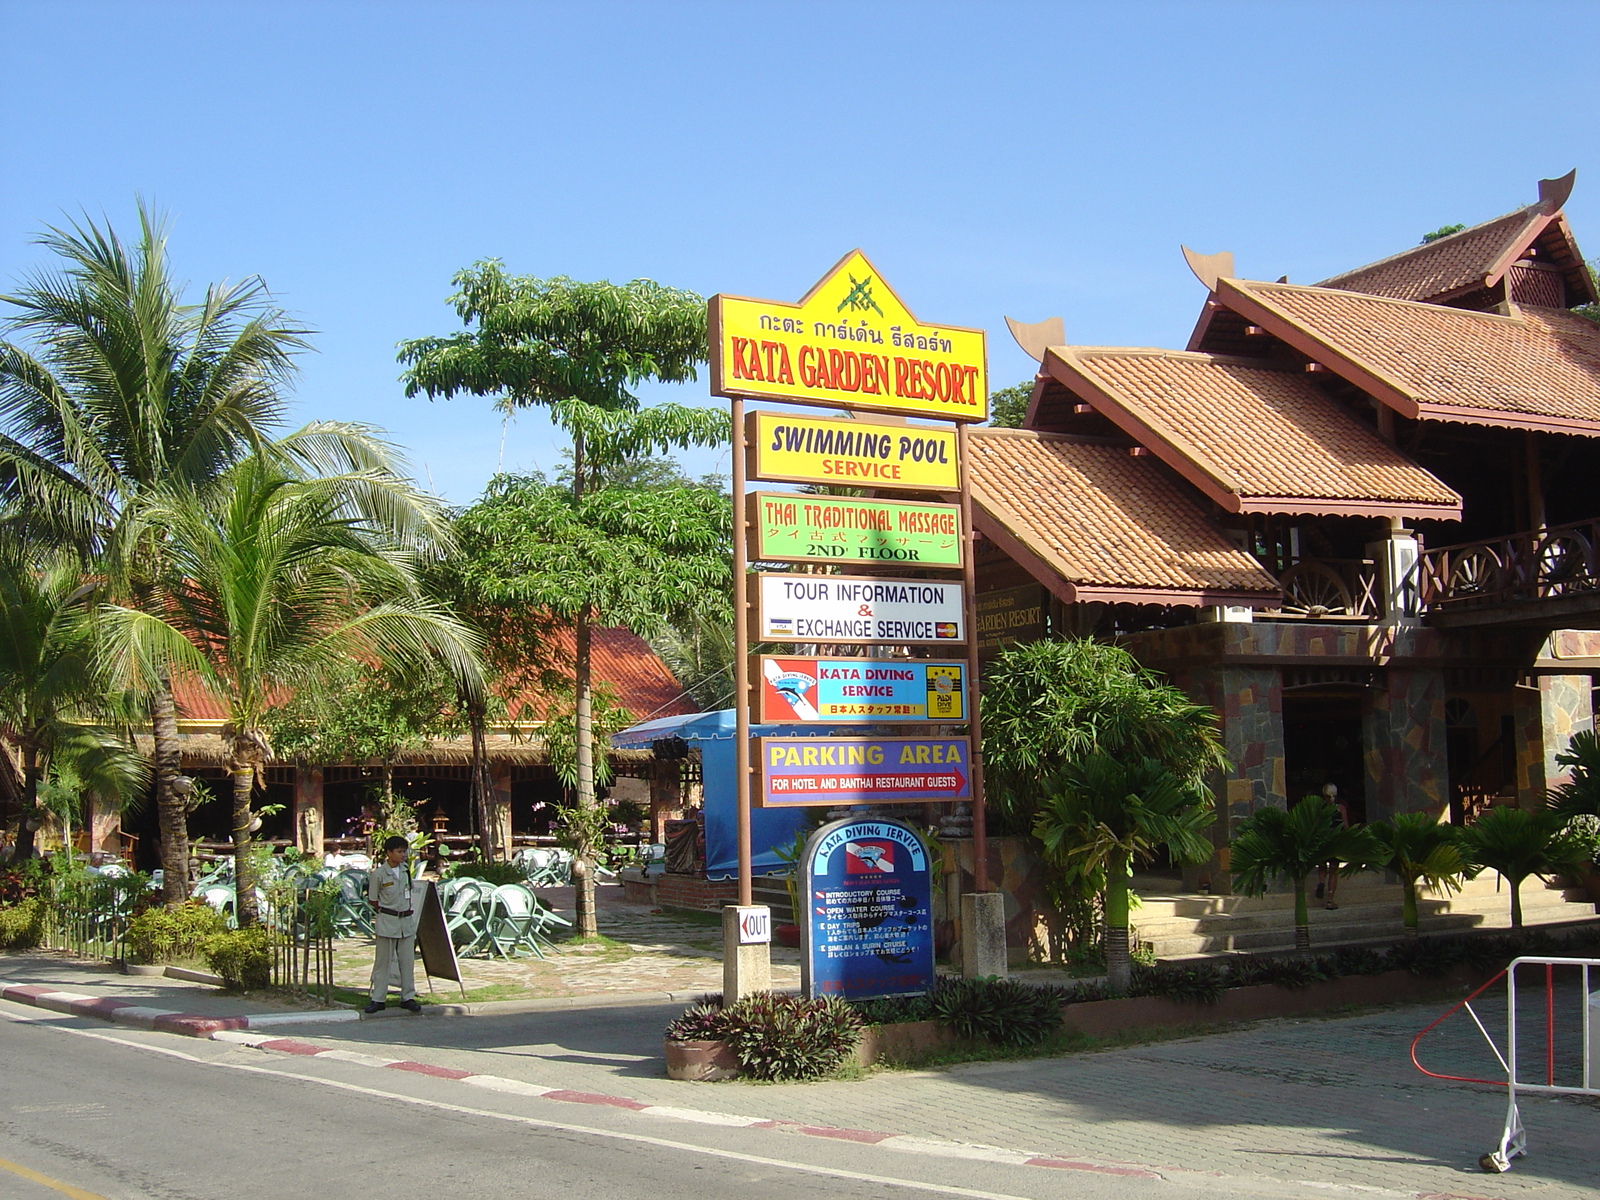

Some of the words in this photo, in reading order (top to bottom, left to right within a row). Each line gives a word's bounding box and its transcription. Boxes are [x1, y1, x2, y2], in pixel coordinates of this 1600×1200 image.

[759, 313, 804, 335] กะตะ
[814, 318, 884, 345] การ์เด้น
[891, 326, 952, 353] รีสอร์ท
[731, 336, 795, 385] KATA
[799, 345, 890, 397] GARDEN
[895, 357, 979, 406] RESORT
[771, 425, 892, 460] SWIMMING
[899, 436, 948, 464] POOL
[822, 459, 901, 480] SERVICE
[765, 502, 797, 527] THAI
[804, 504, 893, 533] TRADITIONAL
[898, 510, 955, 536] MASSAGE
[767, 528, 955, 549] タイ古式マッサージ
[858, 546, 920, 561] FLOOR
[784, 582, 829, 601] TOUR
[837, 584, 944, 605] INFORMATION
[857, 604, 874, 617] &
[1009, 606, 1041, 629] RESORT
[797, 619, 872, 638] EXCHANGE
[877, 621, 933, 639] SERVICE
[819, 668, 861, 681] KATA
[865, 668, 914, 681] DIVING
[842, 685, 894, 697] SERVICE
[770, 745, 884, 767] PARKING
[900, 745, 962, 764] AREA
[772, 778, 789, 790] FOR
[792, 778, 818, 790] HOTEL
[820, 777, 837, 789] AND
[839, 777, 874, 789] BANTHAI
[875, 776, 925, 788] RESTAURANT
[927, 776, 957, 788] GUESTS
[820, 834, 843, 858] KATA
[845, 825, 880, 839] DIVING
[886, 826, 921, 856] SERVICE
[825, 890, 874, 899] INTRODUCTORY
[826, 906, 844, 914] OPEN
[846, 905, 868, 913] WATER
[870, 904, 895, 912] COURSE
[750, 915, 767, 936] OUT
[827, 922, 842, 930] DAY
[843, 921, 860, 929] TRIPS
[827, 943, 852, 952] SIMILAN
[862, 942, 881, 950] SURIN
[883, 940, 907, 948] CRUISE
